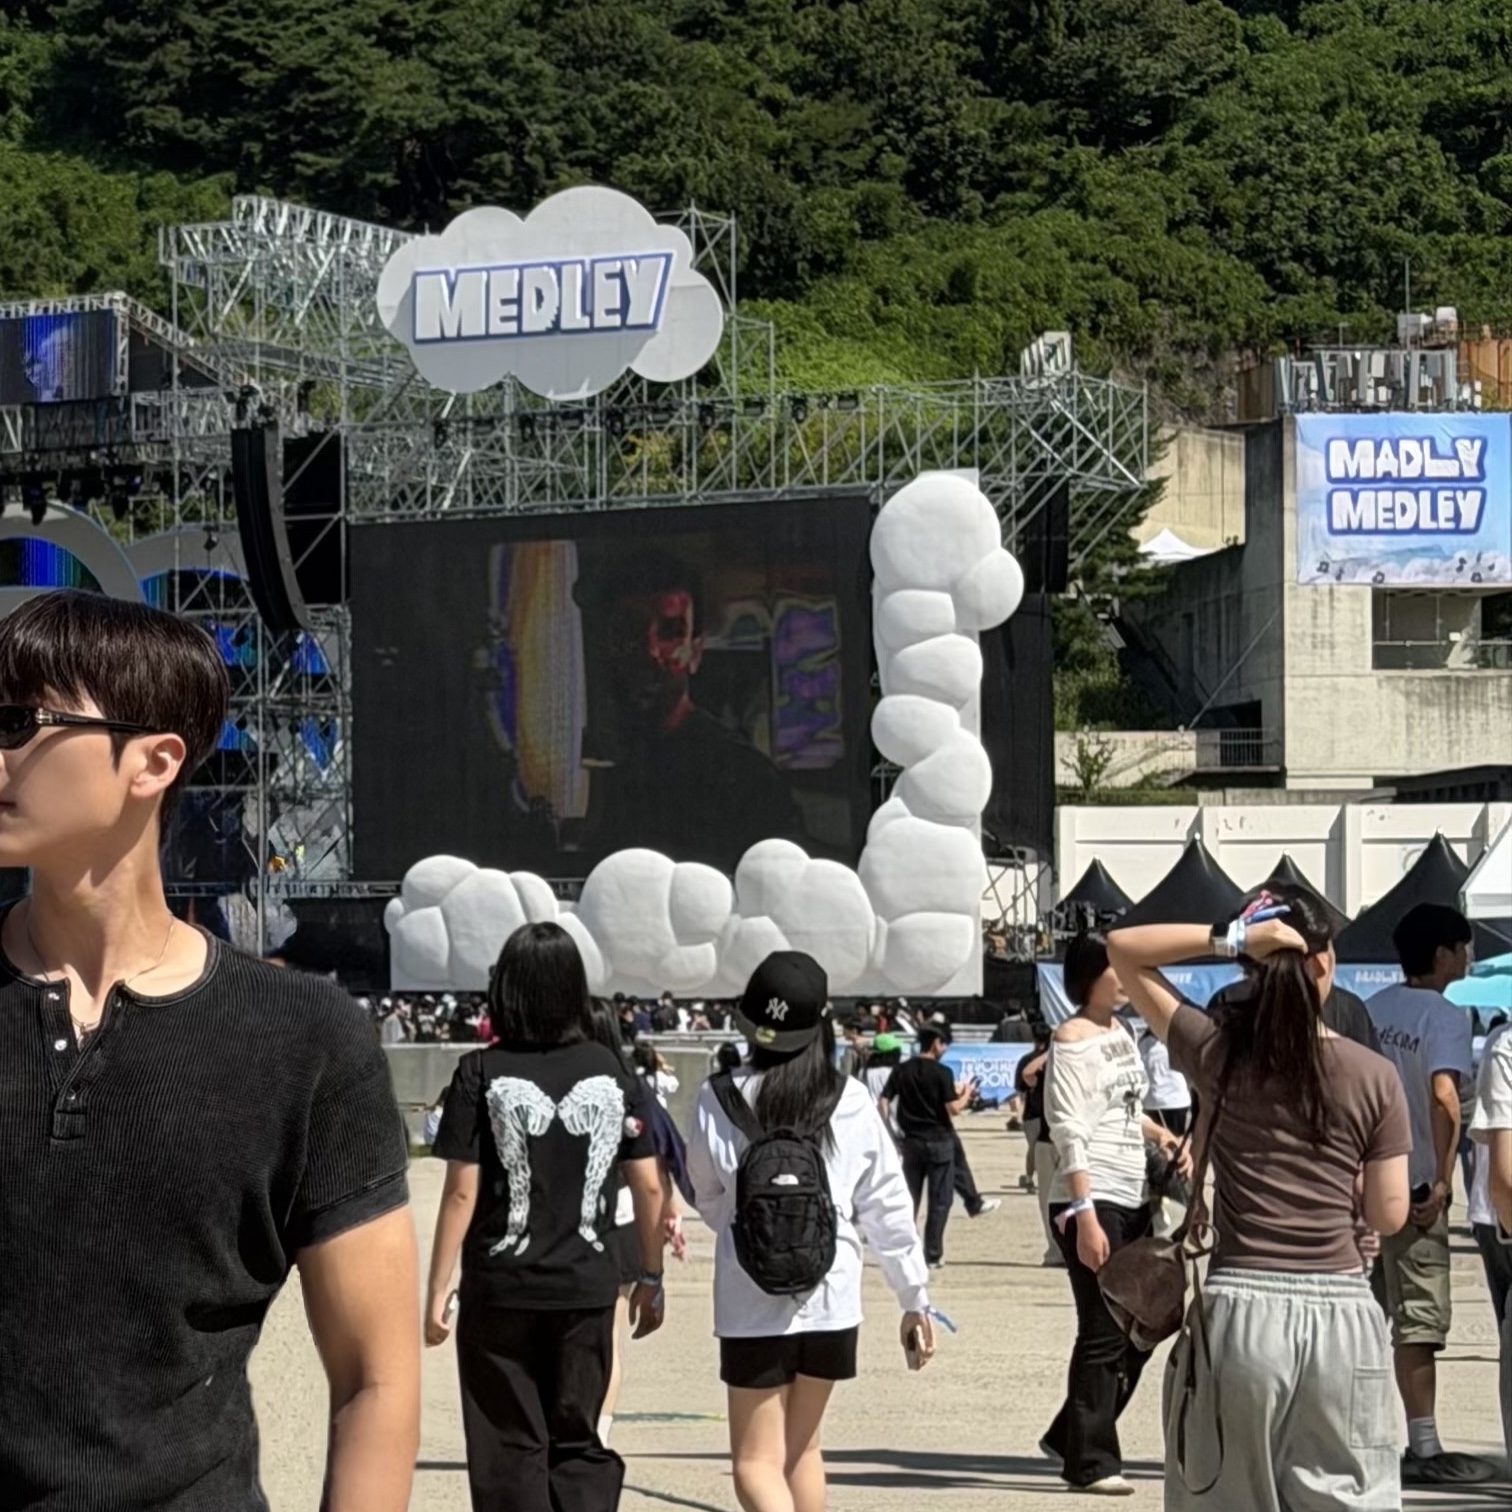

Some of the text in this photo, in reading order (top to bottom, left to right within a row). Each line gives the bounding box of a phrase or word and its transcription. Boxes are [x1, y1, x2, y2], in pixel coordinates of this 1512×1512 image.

[414, 254, 668, 341] MEDLEY
[1329, 438, 1482, 480] MADLY
[1331, 490, 1483, 530] MEDLEY
[765, 997, 789, 1021] NY
